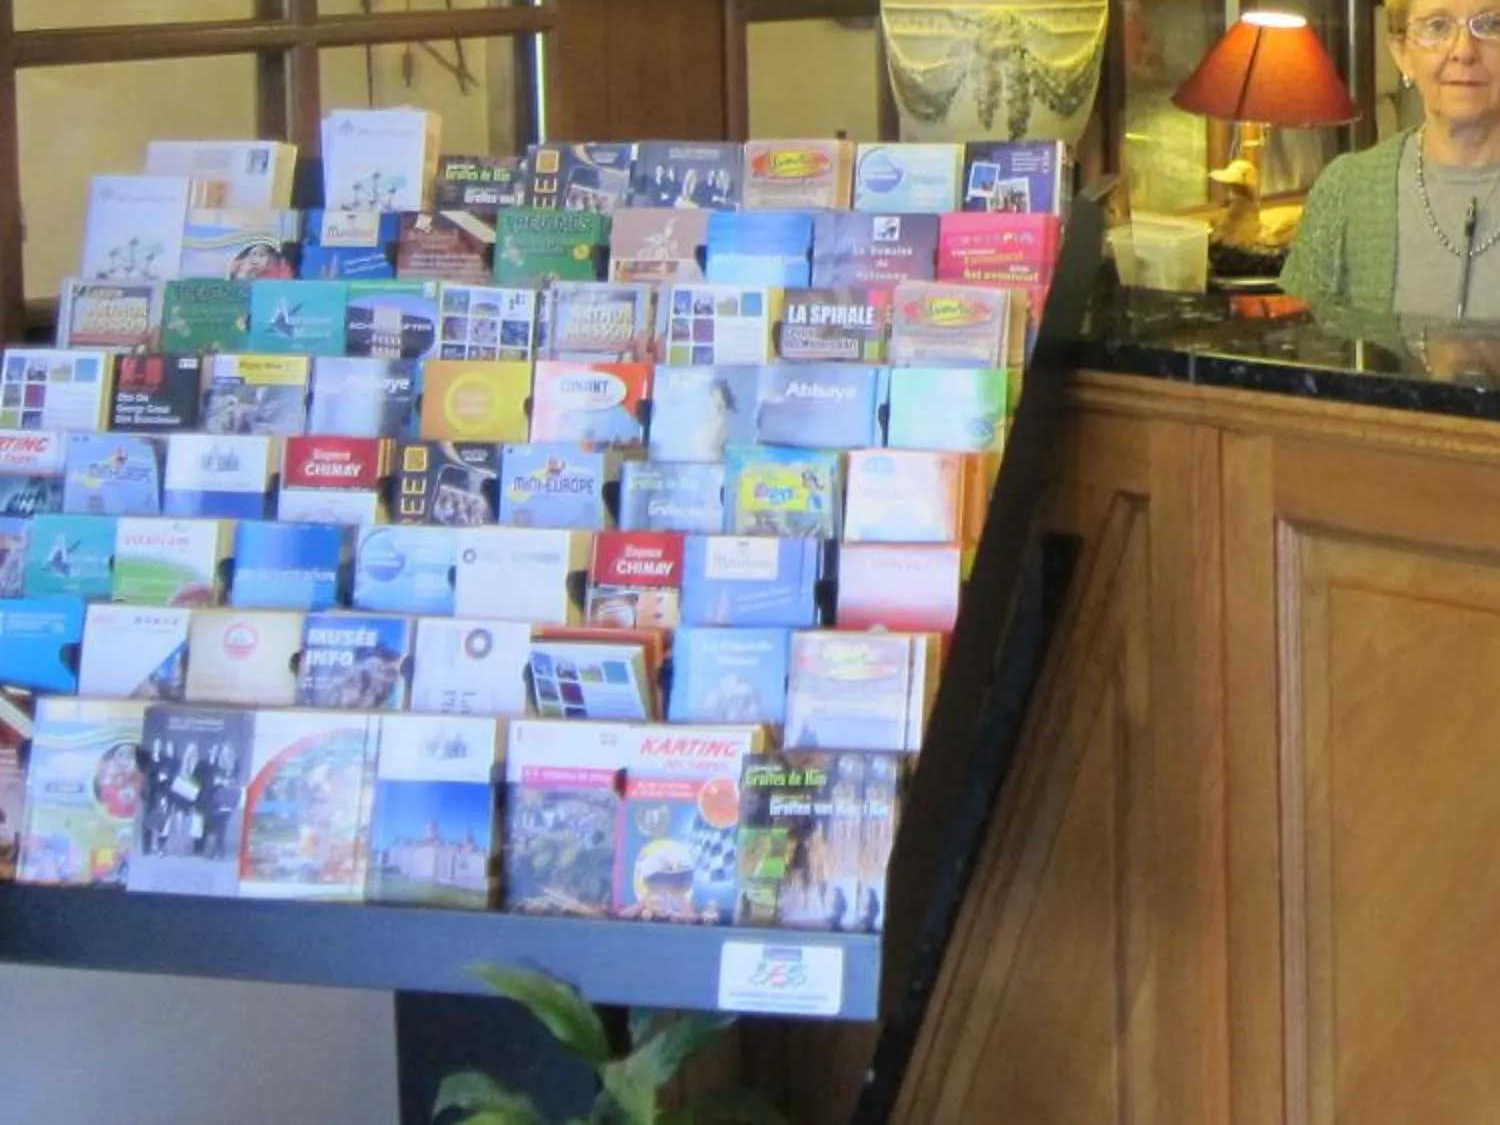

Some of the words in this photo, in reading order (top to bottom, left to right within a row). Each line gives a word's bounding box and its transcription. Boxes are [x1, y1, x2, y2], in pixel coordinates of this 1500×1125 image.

[784, 382, 858, 402] Abbaye
[303, 462, 363, 477] CHIMAY
[513, 476, 595, 495] MINI-EUROPE
[615, 558, 675, 575] CHIMAY
[306, 650, 354, 666] INFO
[639, 737, 744, 759] KARTING
